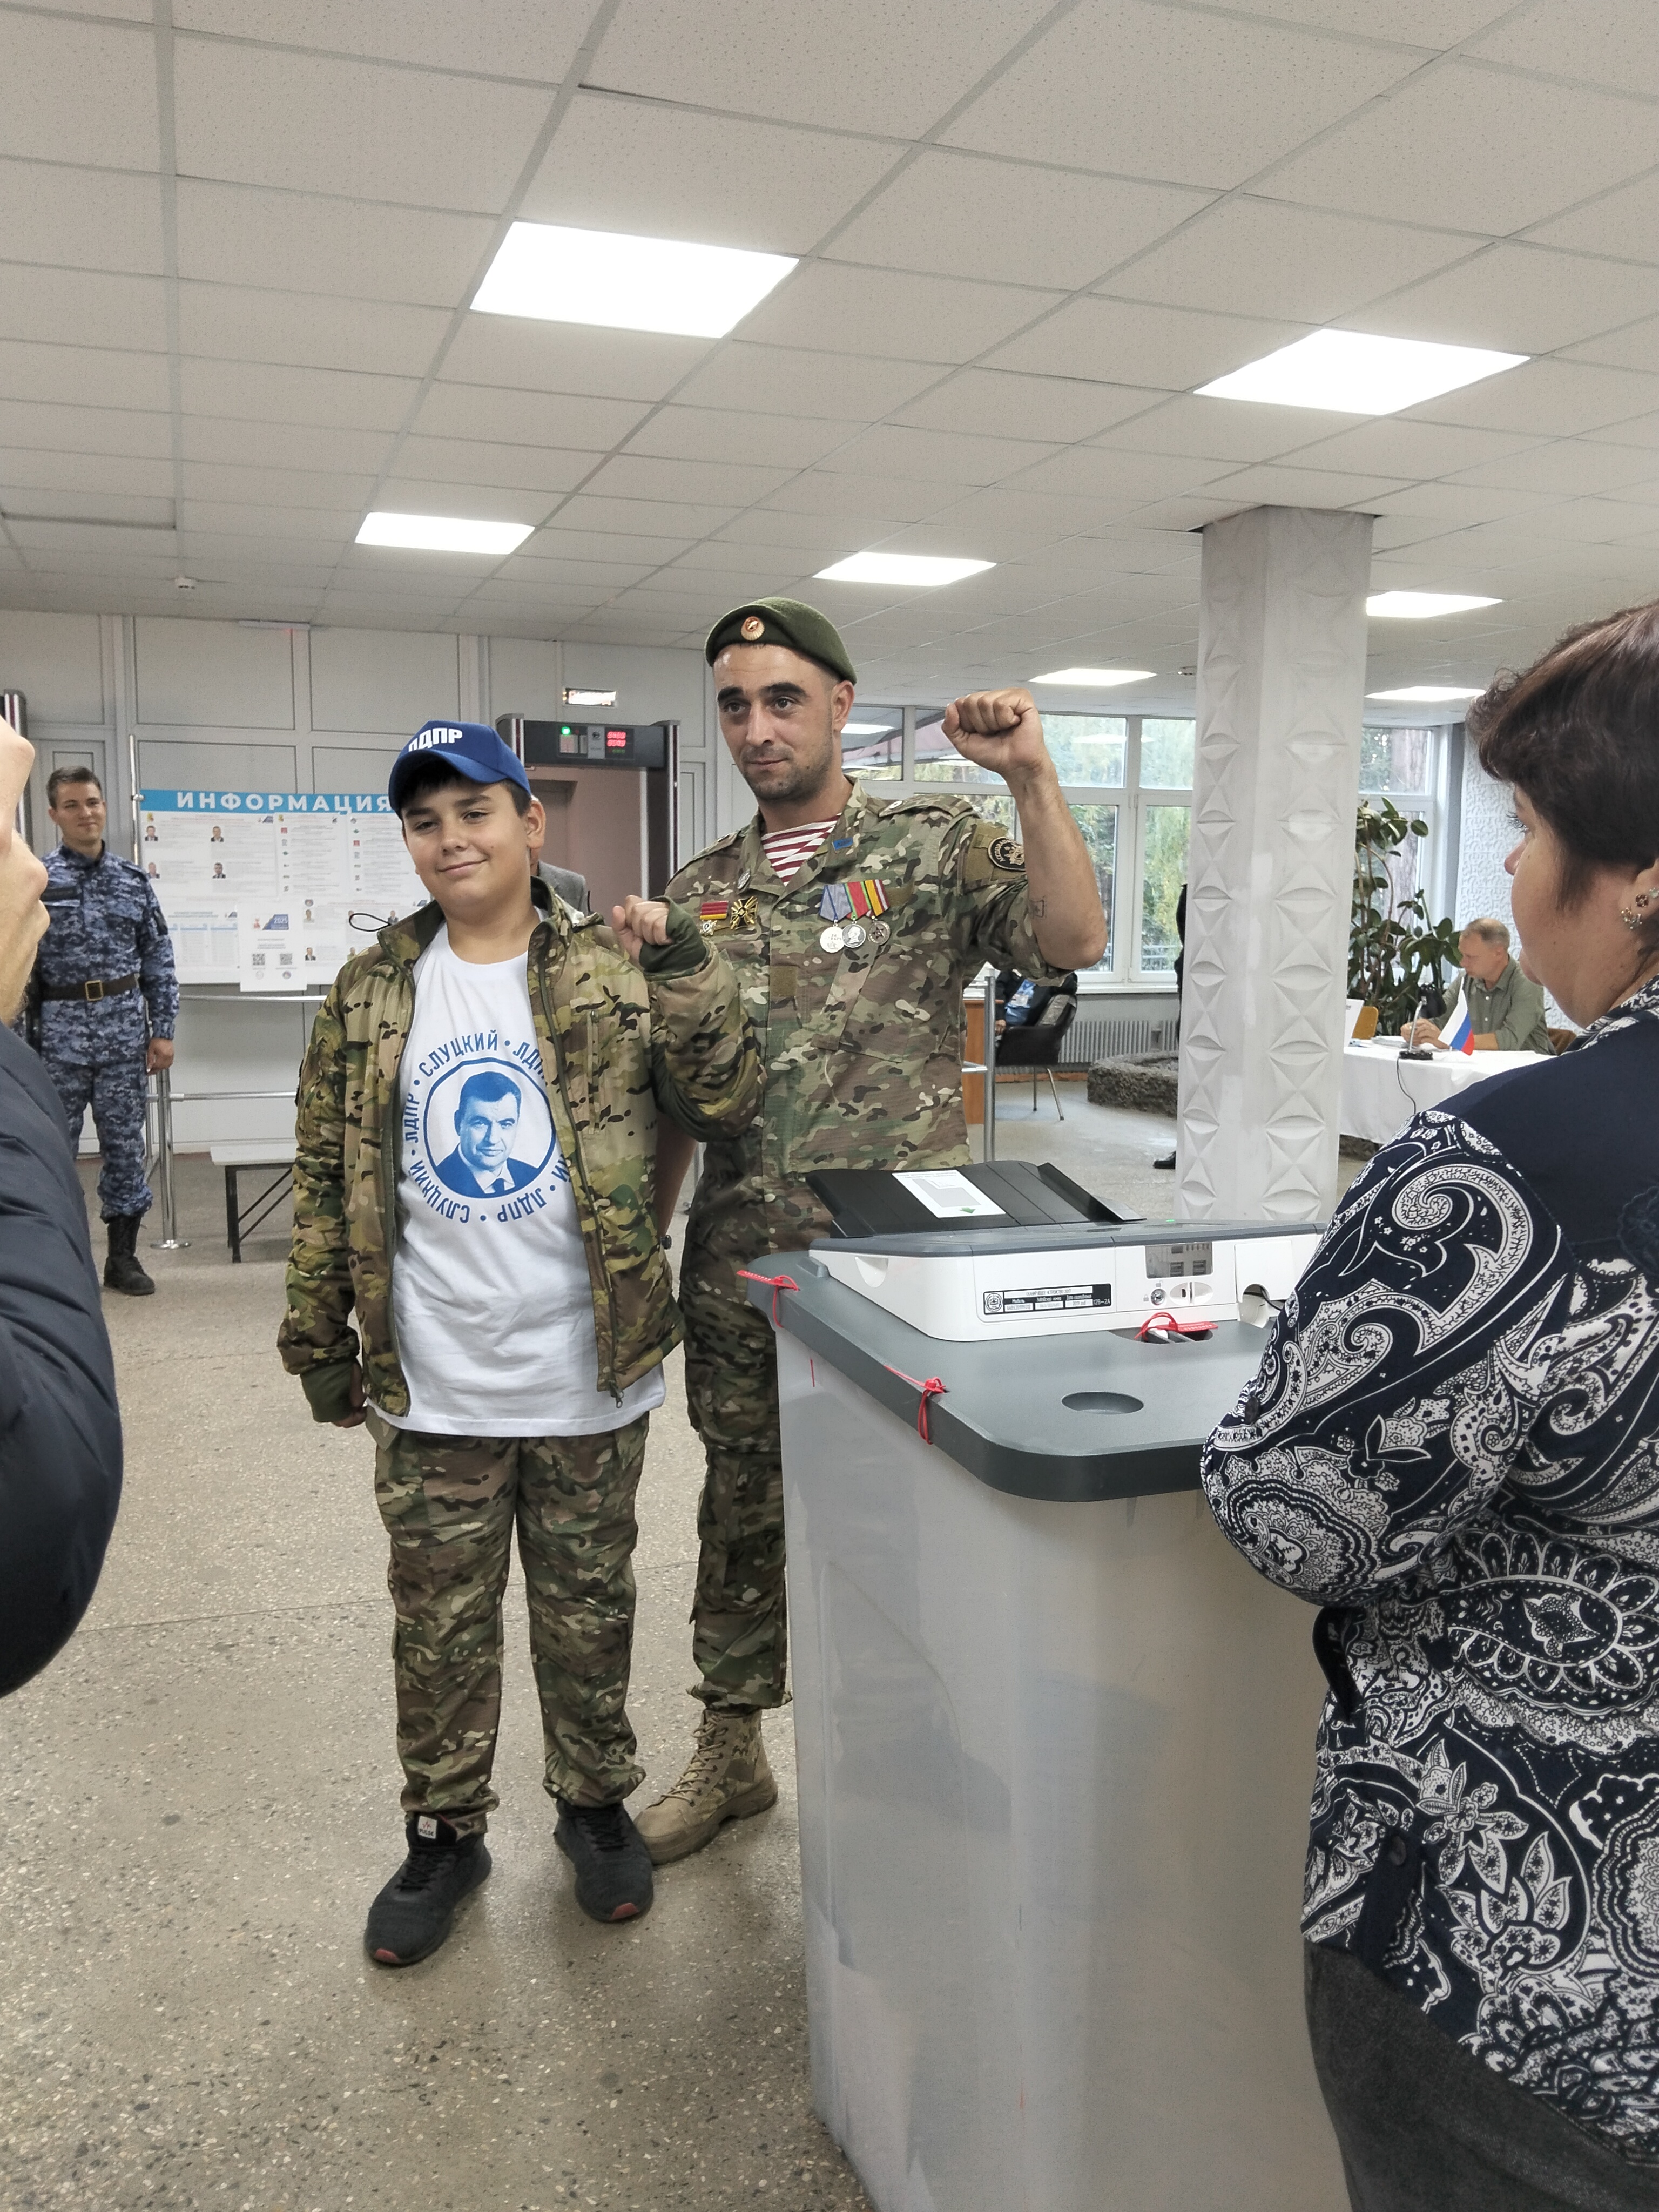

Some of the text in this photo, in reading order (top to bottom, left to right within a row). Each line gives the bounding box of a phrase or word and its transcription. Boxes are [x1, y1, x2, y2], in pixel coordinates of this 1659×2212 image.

[177, 792, 392, 815] ИНФОРМАЦИЯ
[419, 1029, 498, 1077] СЛУЦКИЙ
[403, 1093, 420, 1144] ЛДПР
[409, 1160, 470, 1224] СЛУЦКИЙ
[497, 1188, 547, 1223] ЛДПР
[419, 1828, 434, 1837] PULSE
